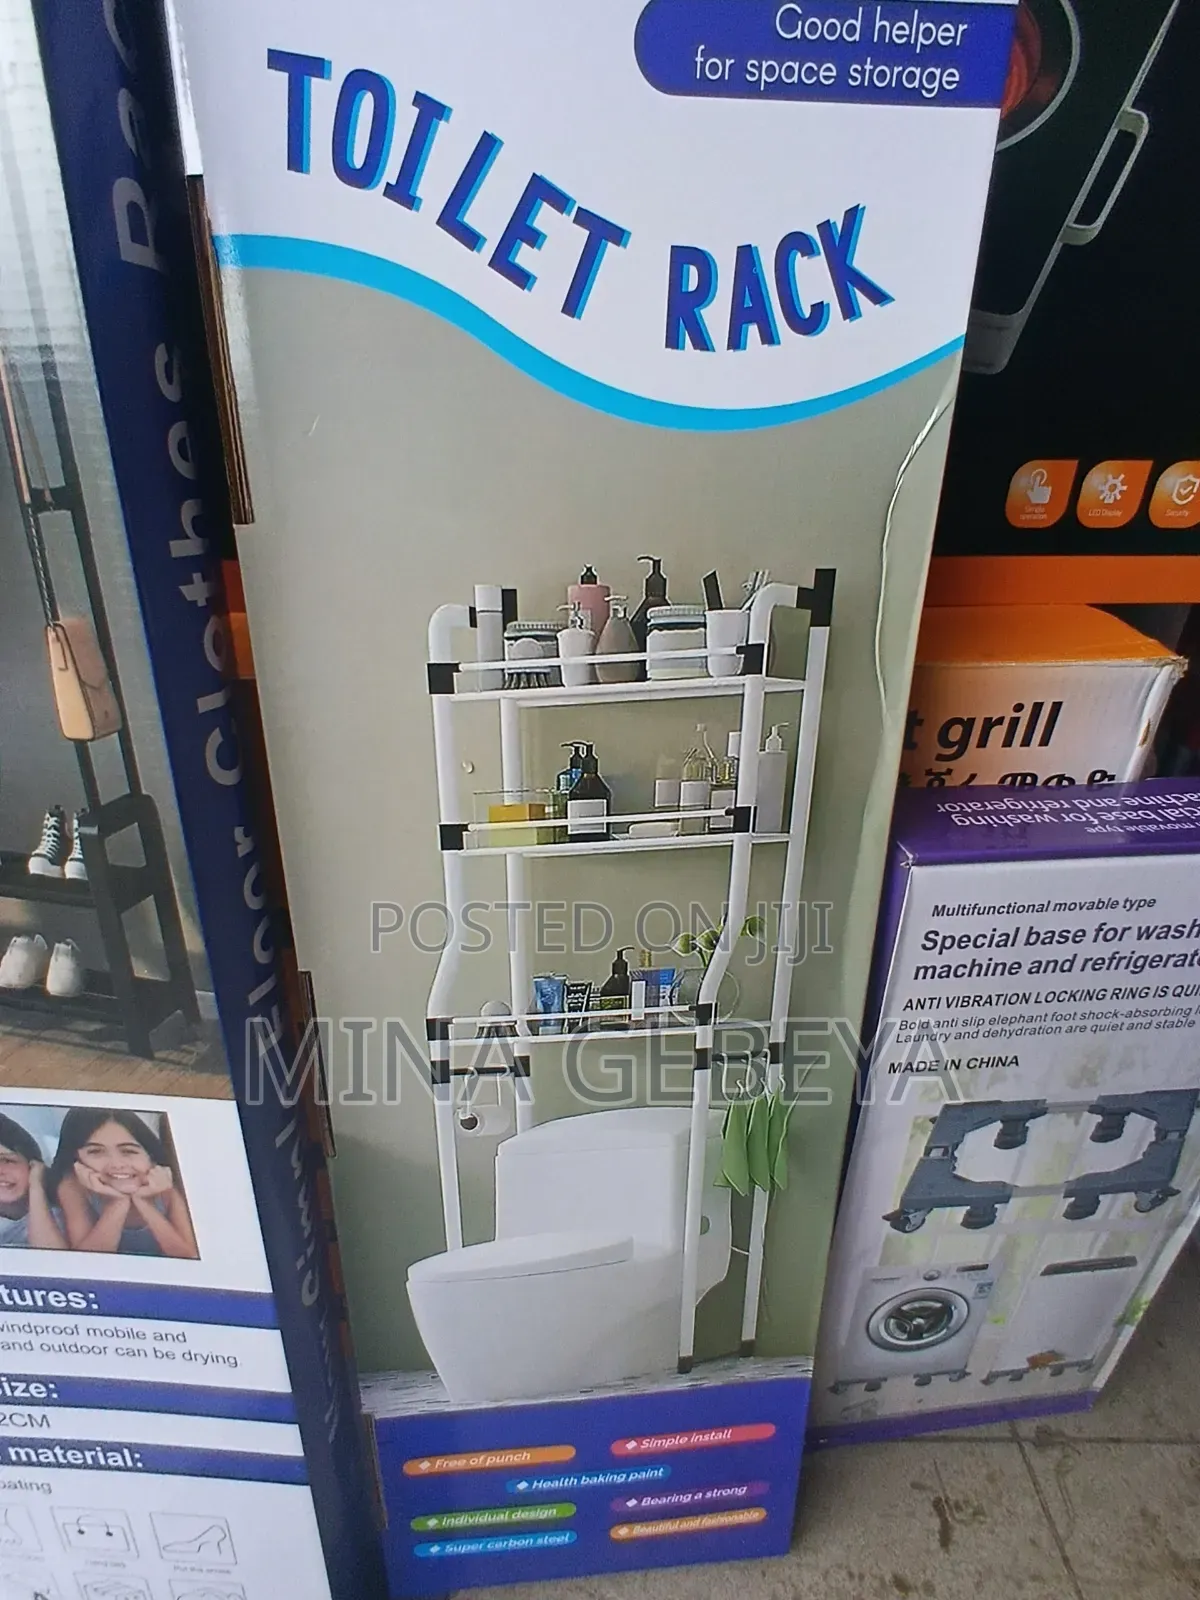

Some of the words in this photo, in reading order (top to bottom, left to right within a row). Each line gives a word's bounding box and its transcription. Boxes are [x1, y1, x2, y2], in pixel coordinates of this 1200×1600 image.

[775, 2, 863, 42] Good
[873, 5, 968, 54] helper
[694, 44, 735, 80] for
[745, 57, 837, 91] space
[847, 56, 961, 98] storage
[267, 48, 631, 320] TOILET
[665, 203, 894, 353] RACK
[935, 701, 1063, 762] grill
[937, 797, 1070, 814] refrigerator
[1072, 798, 1120, 810] and
[1126, 793, 1200, 807] achine
[951, 812, 1058, 828] washing
[1063, 811, 1098, 825] for
[1102, 810, 1163, 822] base
[1157, 807, 1200, 820] cial
[1084, 824, 1124, 834] type
[1126, 821, 1197, 834] movable
[931, 899, 1051, 917] Multifunctional
[1052, 897, 1119, 913] movable
[1122, 896, 1157, 912] type
[920, 926, 1020, 956] Special
[1023, 923, 1087, 948] base
[1092, 921, 1132, 944] for
[913, 957, 1022, 981] machine
[1027, 952, 1078, 976] and
[902, 997, 942, 1012] ANTI
[944, 991, 1032, 1010] VIBRATION
[1033, 987, 1108, 1005] LOCKING
[1109, 985, 1150, 1001] RING
[1152, 984, 1170, 999] IS
[898, 1019, 930, 1031] Bold
[932, 1017, 959, 1029] anti
[961, 1015, 985, 1028] slip
[988, 1012, 1048, 1027] elephant
[1050, 1010, 1077, 1022] foot
[1079, 1004, 1193, 1022] shock-absorbing
[896, 1031, 951, 1044] Laundry
[954, 1029, 979, 1041] and
[982, 1024, 1062, 1040] dehydration
[1064, 1024, 1087, 1034] are
[1090, 1020, 1125, 1035] quiet
[1126, 1019, 1153, 1031] and
[1154, 1016, 1196, 1030] stable
[888, 1060, 939, 1075] MADE
[943, 1057, 962, 1071] IN
[965, 1054, 1020, 1070] CHINA
[86, 1325, 147, 1340] mobile
[152, 1330, 187, 1344] and
[0, 1339, 34, 1351] and
[40, 1342, 109, 1356] outdoor
[115, 1346, 148, 1358] can
[153, 1347, 176, 1360] be
[0, 1376, 58, 1398] ize:
[640, 1435, 688, 1449] Simple
[690, 1429, 733, 1441] install
[8, 1445, 143, 1468] material:
[435, 1456, 467, 1469] Free
[469, 1453, 483, 1465] of
[485, 1451, 531, 1466] punch
[532, 1477, 577, 1490] Health
[580, 1471, 627, 1486] baking
[628, 1467, 664, 1481] paint
[641, 1491, 691, 1507] Bearing
[705, 1485, 748, 1498] strong
[442, 1512, 510, 1527] Individual
[511, 1507, 557, 1520] design
[632, 1521, 680, 1534] Beautiful
[680, 1518, 701, 1530] and
[701, 1511, 760, 1526] fashionable
[444, 1542, 484, 1554] Super
[487, 1538, 535, 1549] carbon
[536, 1532, 570, 1546] steel
